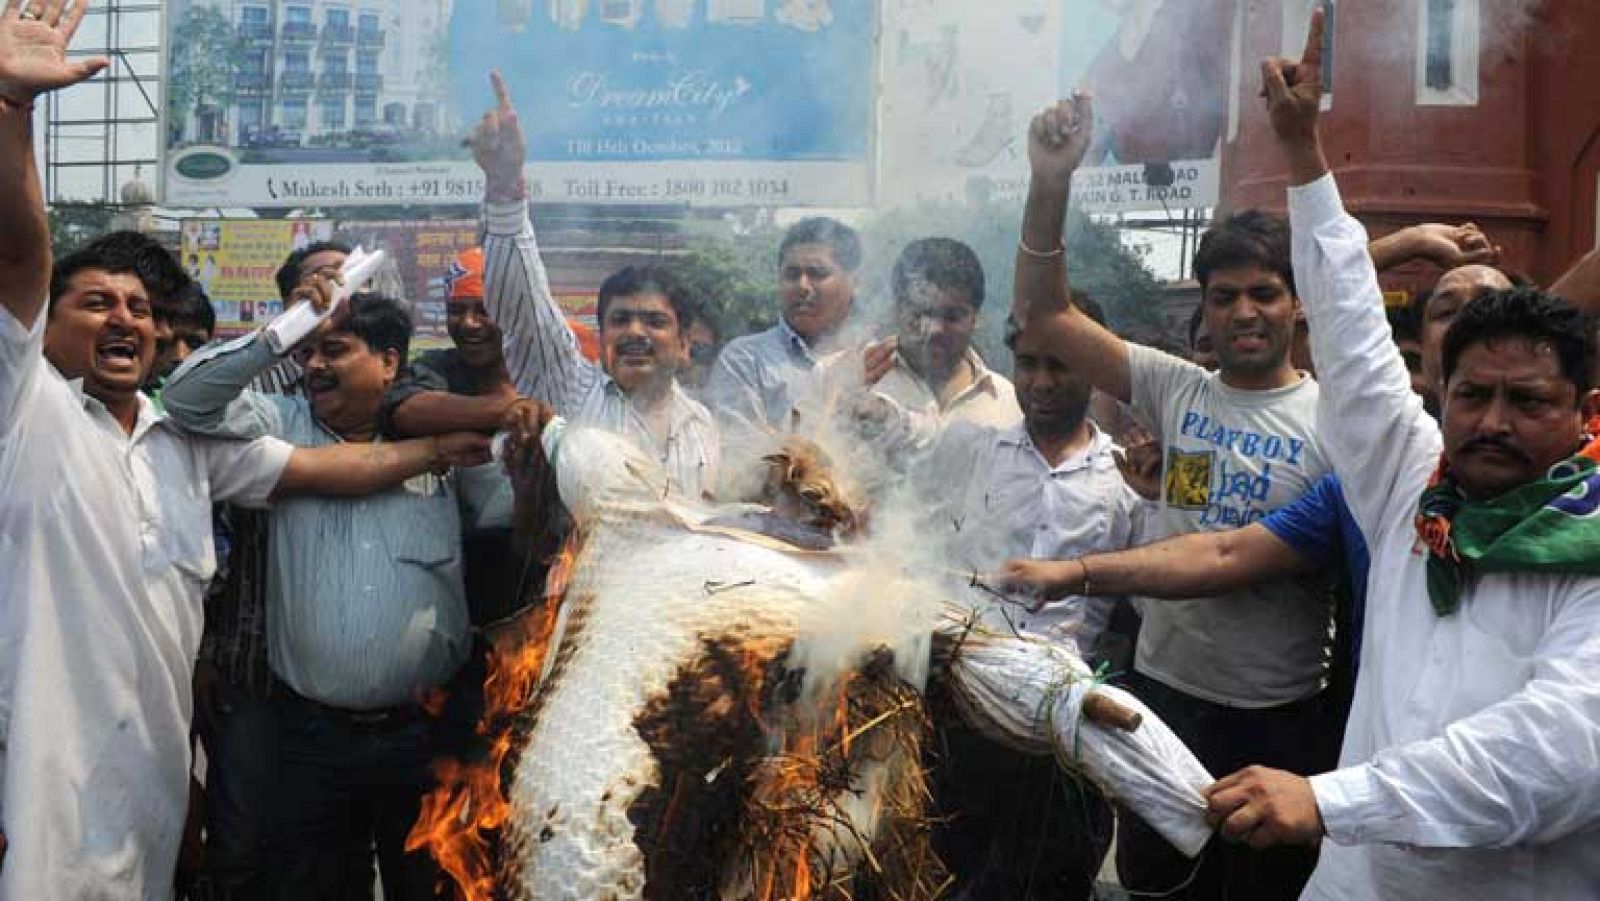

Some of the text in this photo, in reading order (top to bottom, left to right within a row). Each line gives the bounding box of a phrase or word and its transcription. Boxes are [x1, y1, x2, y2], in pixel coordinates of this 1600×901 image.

[281, 179, 350, 197] Mukesh
[354, 179, 392, 197] Seth
[564, 178, 599, 197] Toll
[1147, 186, 1192, 201] ROAD
[1180, 412, 1304, 465] PLAYBOY
[1216, 459, 1270, 501] bad
